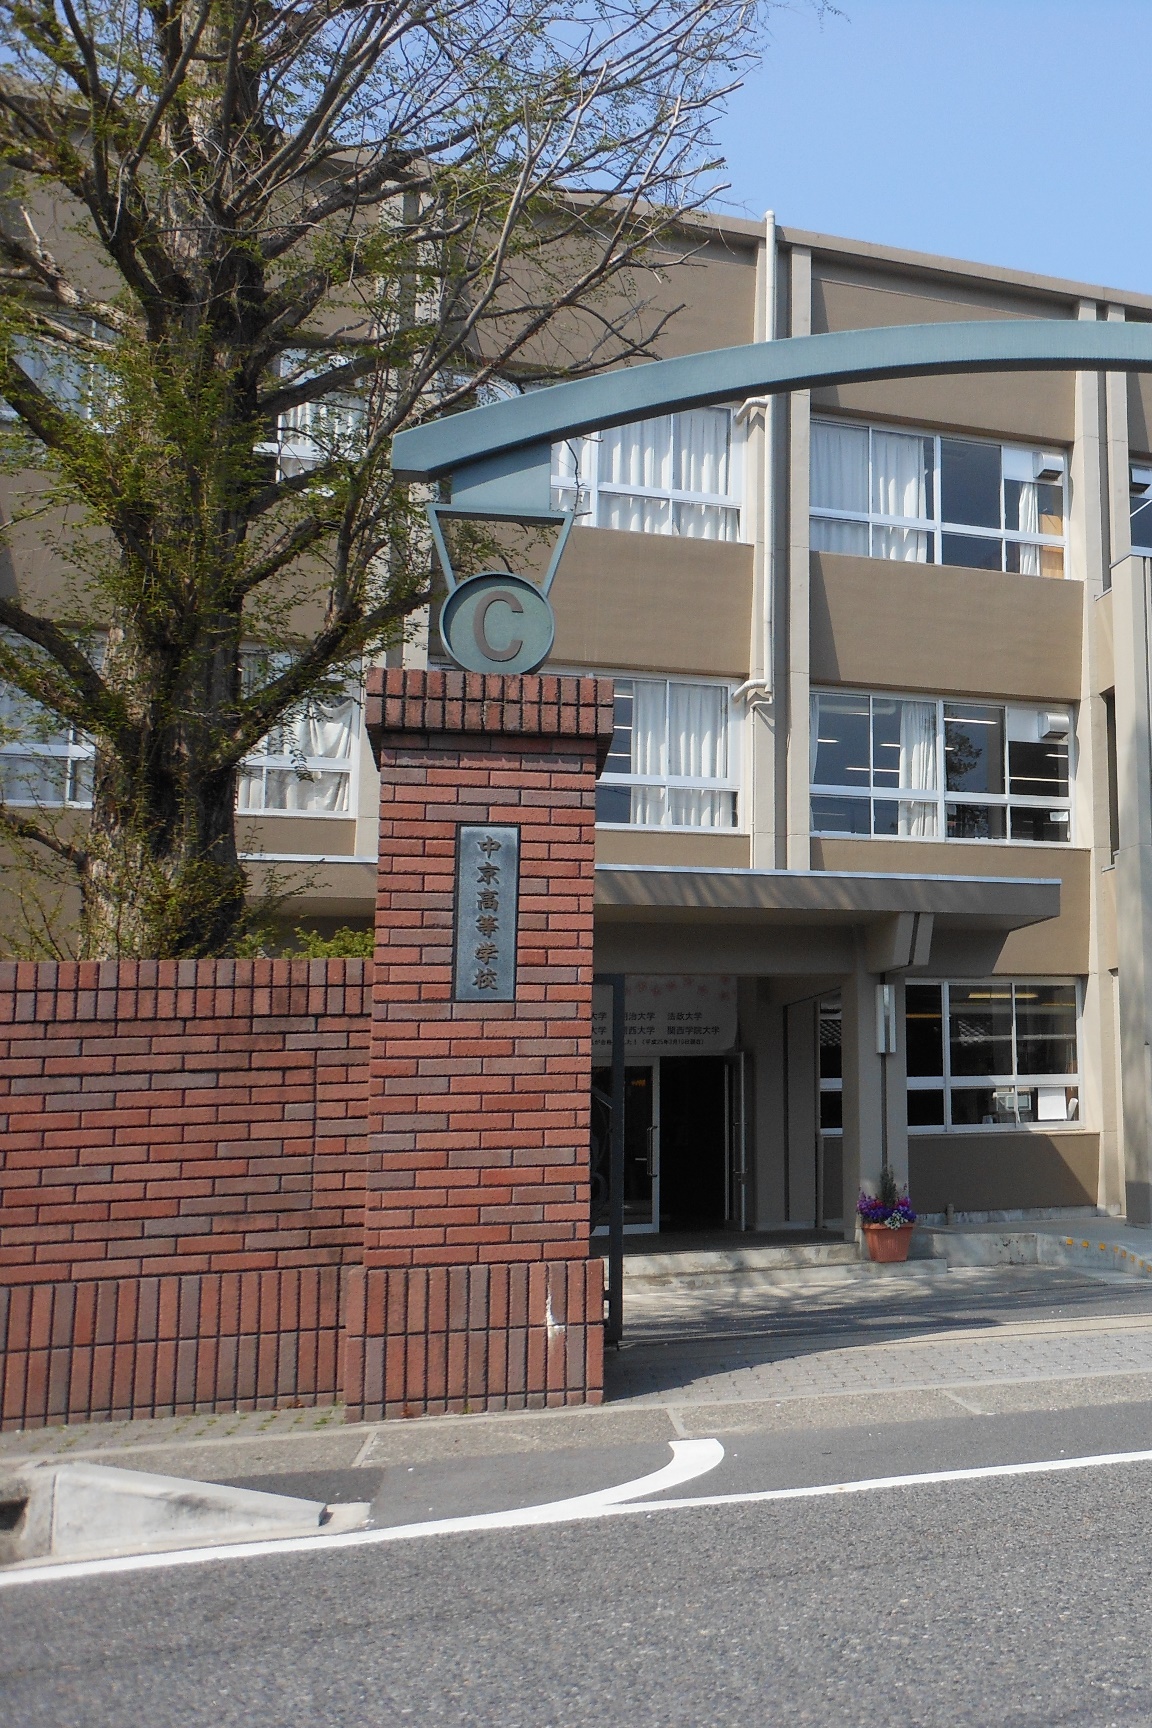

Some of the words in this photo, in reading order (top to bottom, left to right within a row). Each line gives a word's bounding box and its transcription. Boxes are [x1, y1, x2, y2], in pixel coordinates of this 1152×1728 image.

[473, 590, 524, 662] C
[472, 835, 501, 991] 中京高等学校
[667, 1012, 703, 1021] 法政大学
